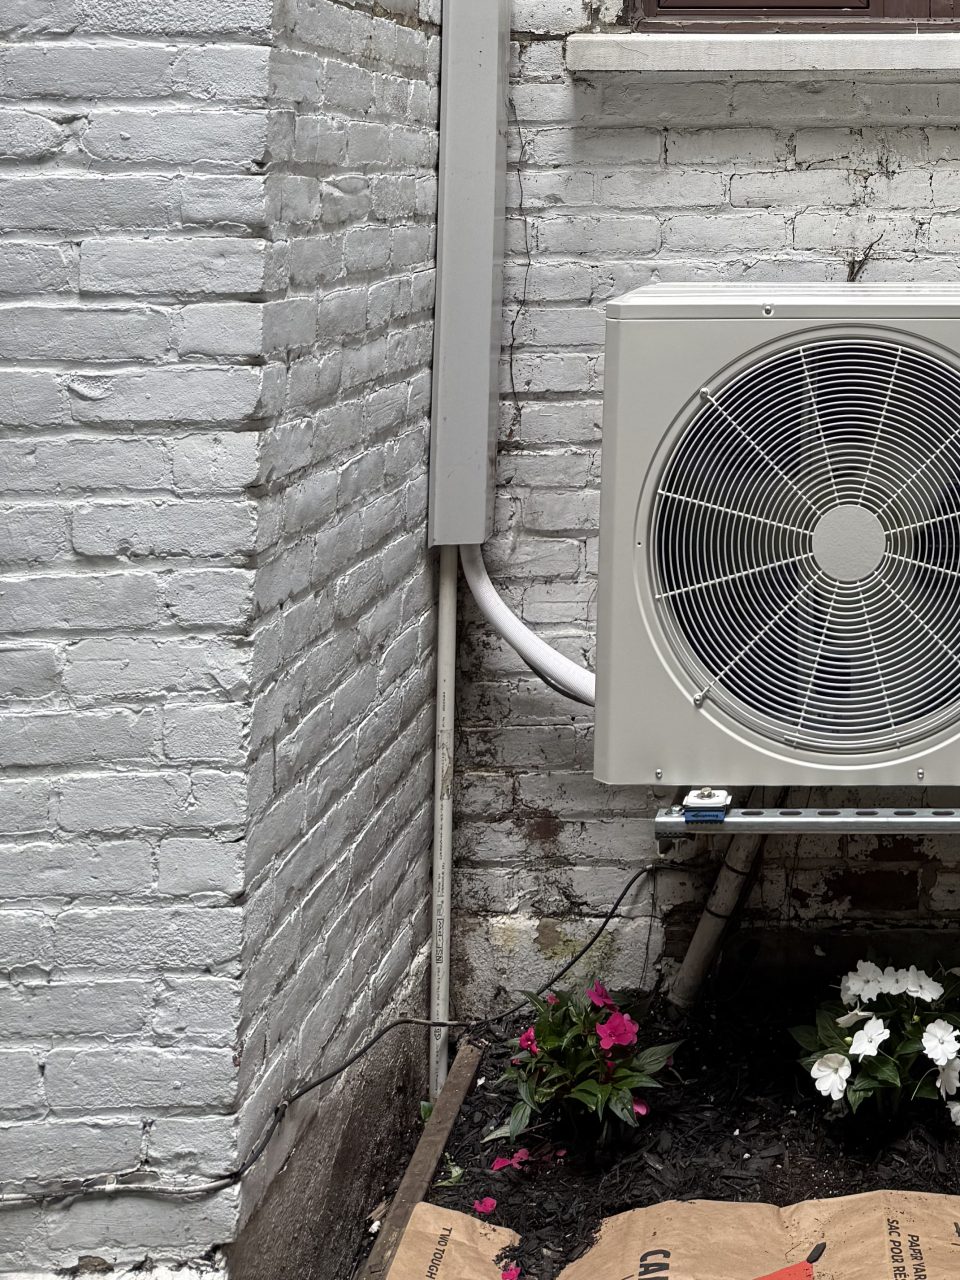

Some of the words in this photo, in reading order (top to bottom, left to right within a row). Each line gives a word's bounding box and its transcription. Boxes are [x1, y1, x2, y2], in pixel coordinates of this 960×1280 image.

[438, 1227, 452, 1246] TWO
[887, 1218, 900, 1237] SAC
[889, 1239, 904, 1263] POUR
[425, 1248, 446, 1280] TOUGH
[638, 1249, 671, 1280] CA
[893, 1266, 909, 1280] RÉ
